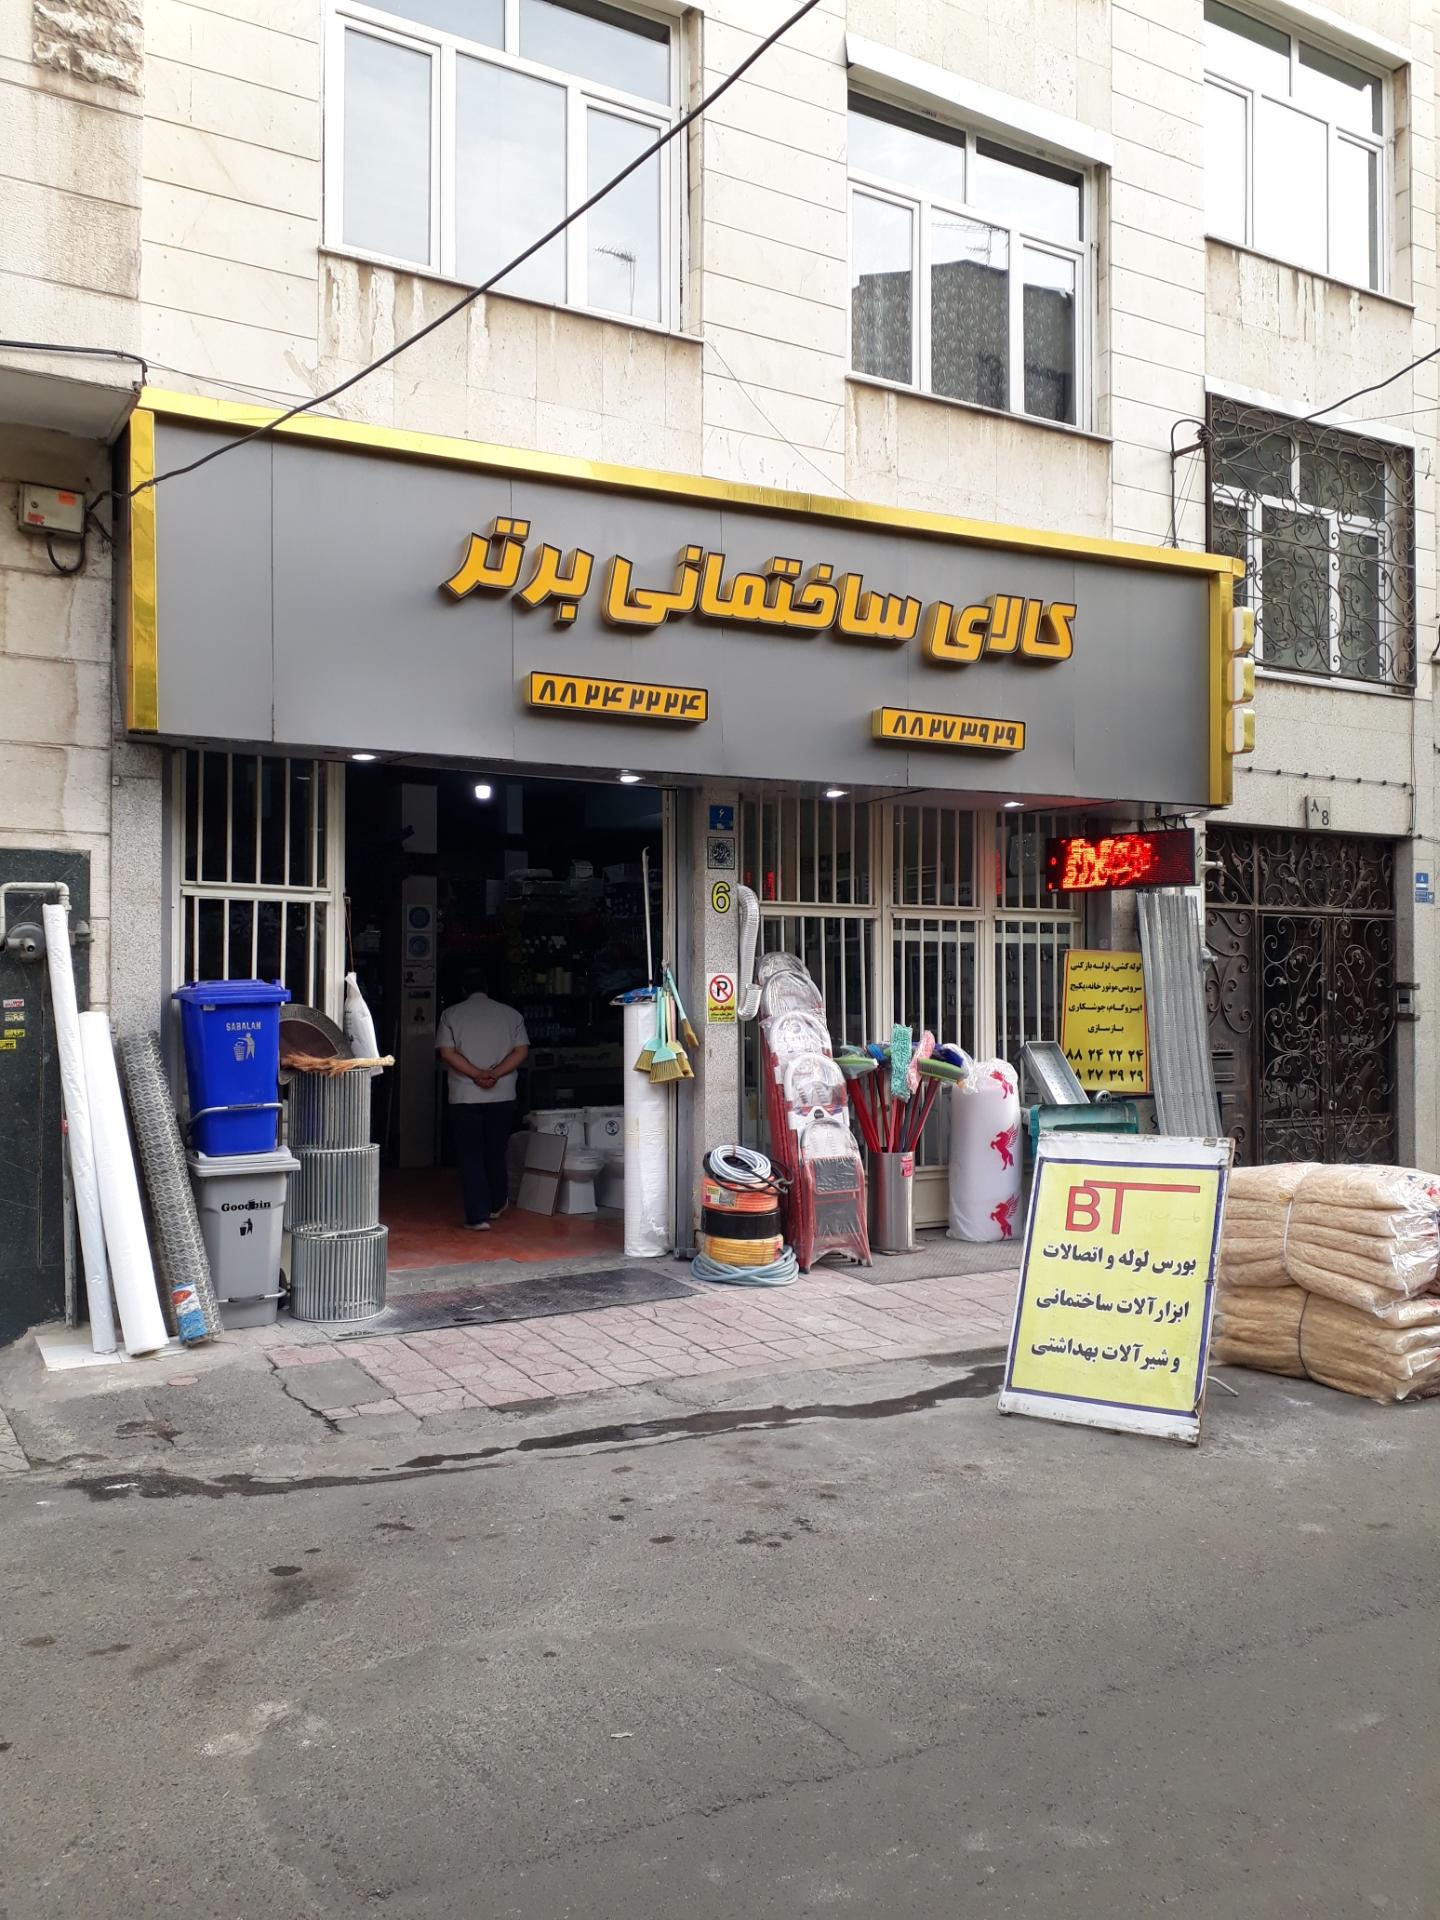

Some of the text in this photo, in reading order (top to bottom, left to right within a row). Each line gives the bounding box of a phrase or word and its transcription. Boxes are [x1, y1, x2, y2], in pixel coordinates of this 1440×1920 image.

[442, 517, 1076, 661] کالای ساختمانی برتر
[1321, 809, 1329, 826] 8
[711, 881, 731, 914] 6
[1042, 1243, 1197, 1276] بورس لوله و اتصالات
[1036, 1288, 1113, 1312] ساختمانی
[1031, 1337, 1099, 1363] بهداشتی
[1170, 1355, 1181, 1373] و
